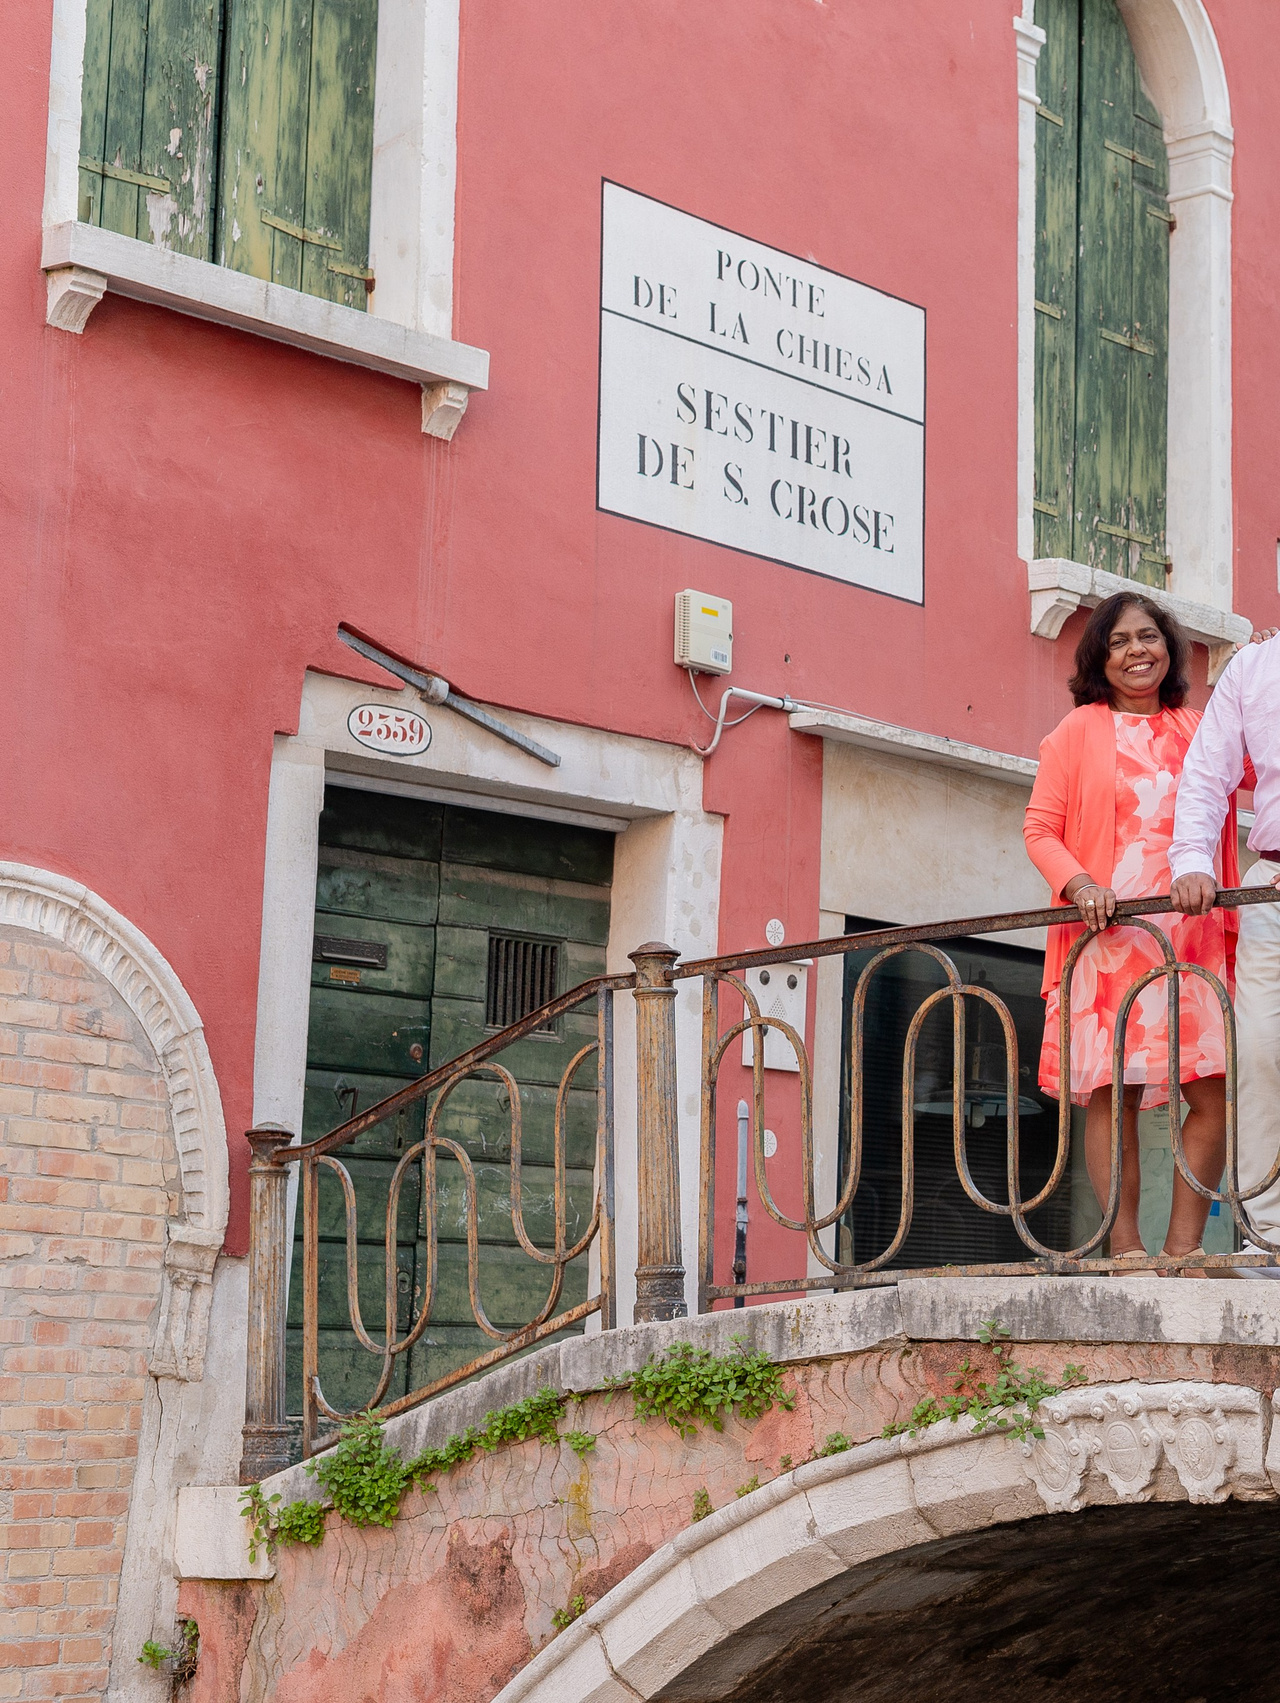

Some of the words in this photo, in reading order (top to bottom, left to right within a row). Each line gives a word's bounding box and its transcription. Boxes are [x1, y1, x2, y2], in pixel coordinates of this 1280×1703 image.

[717, 249, 825, 318] PONTE
[633, 275, 677, 319] DE
[709, 301, 750, 345] LA
[776, 328, 893, 396] CHIESA
[676, 382, 853, 479] SESTIER
[637, 432, 695, 491] DE
[723, 462, 749, 506] S.
[769, 478, 895, 554] CROSE
[357, 709, 424, 745] 2359
